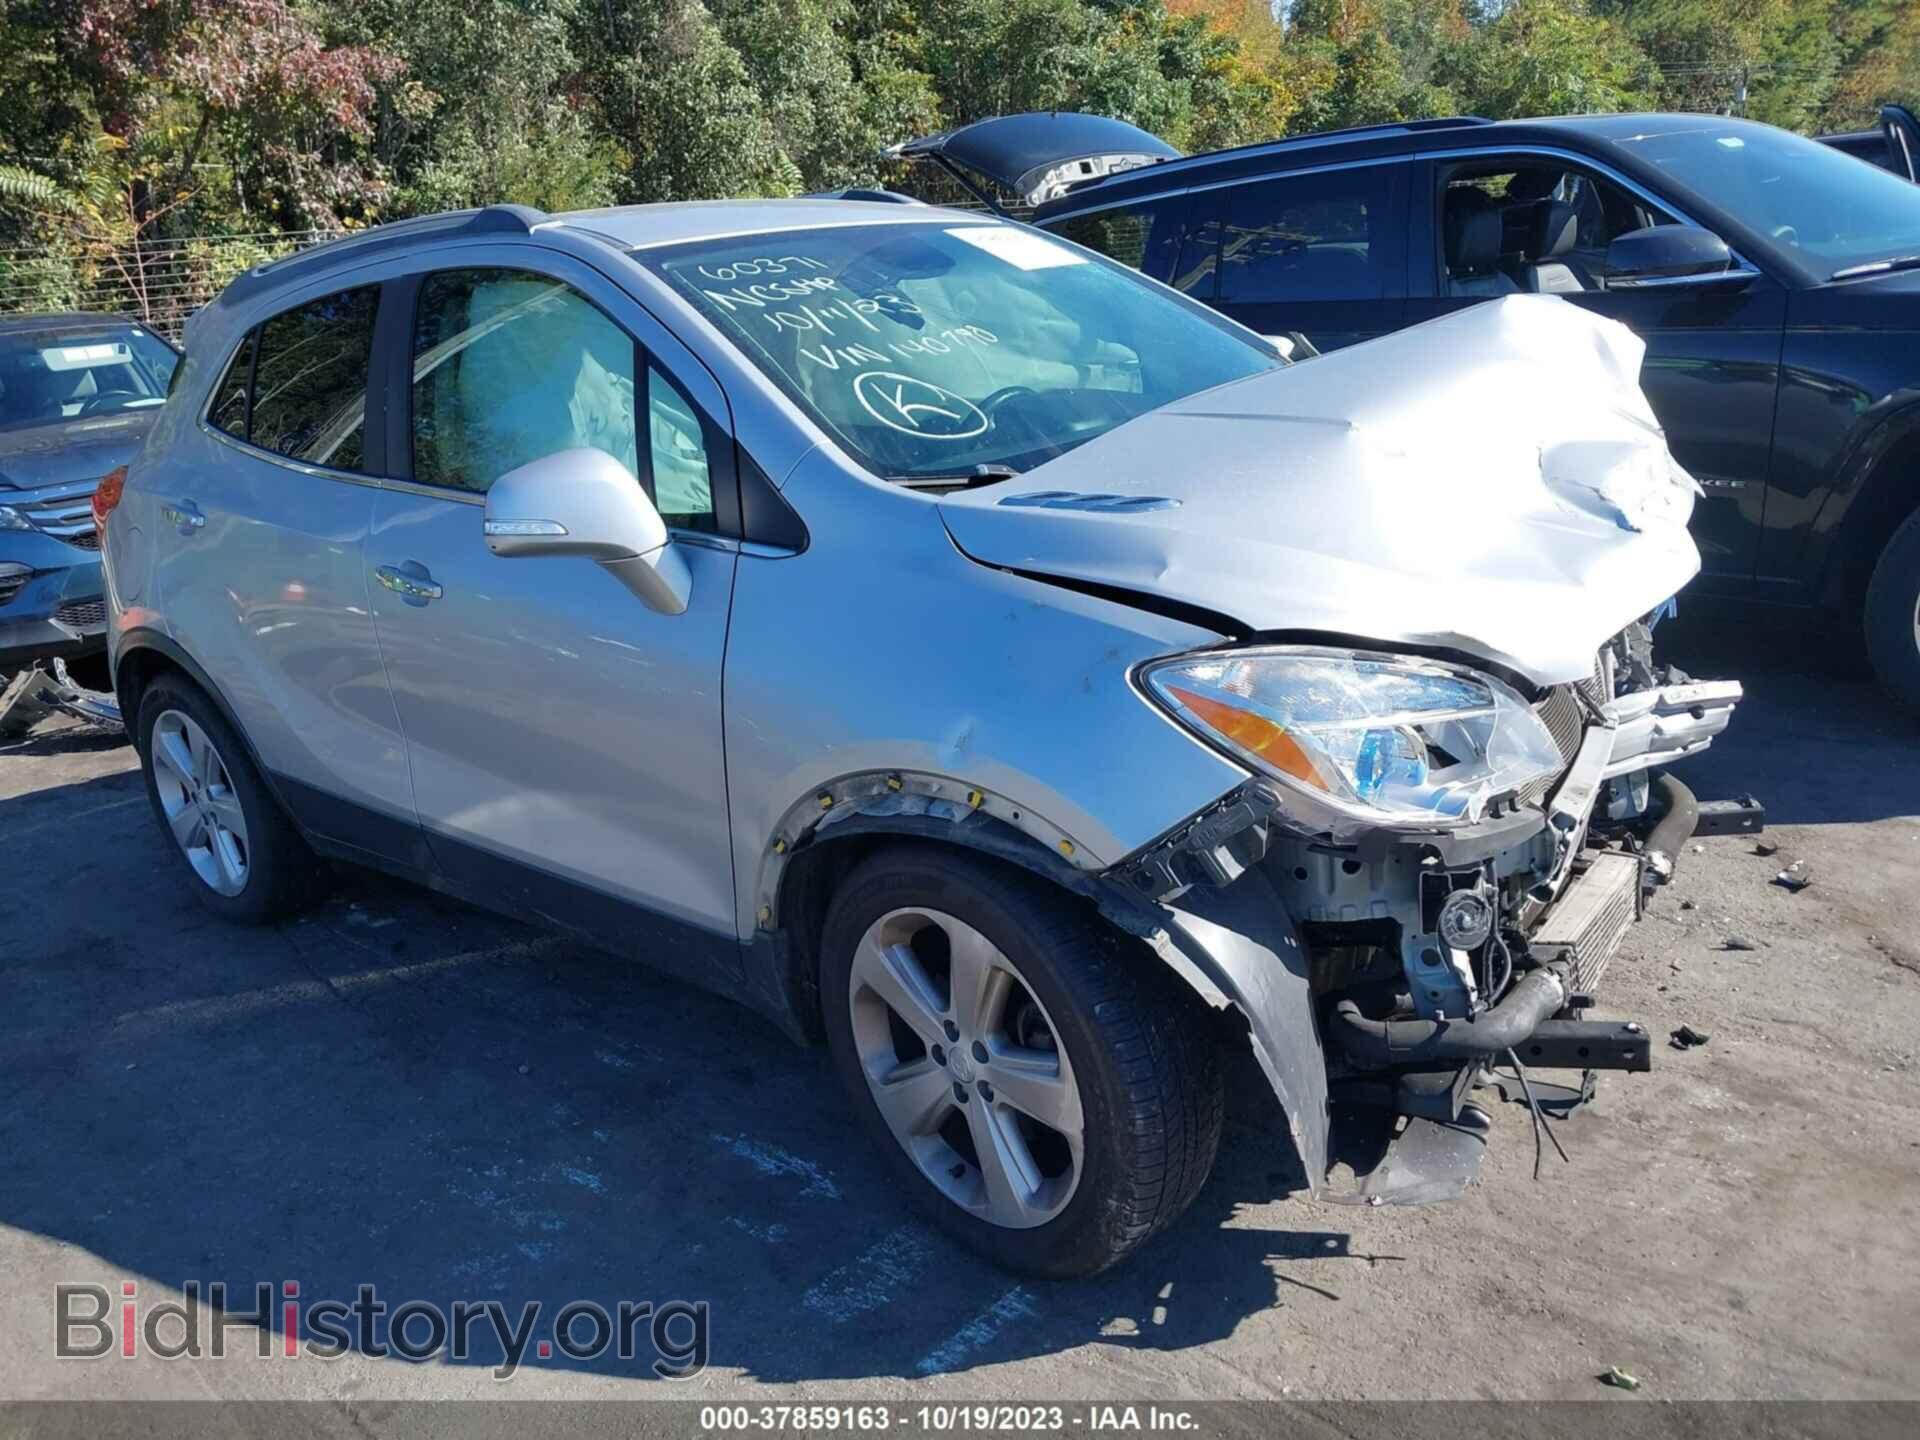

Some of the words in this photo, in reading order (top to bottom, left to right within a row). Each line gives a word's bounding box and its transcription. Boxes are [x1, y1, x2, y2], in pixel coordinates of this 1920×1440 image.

[699, 256, 828, 280] 60371
[763, 295, 922, 336] 10/11/23
[800, 343, 893, 369] VIN
[870, 382, 961, 427] K
[1700, 479, 1745, 488] KEE
